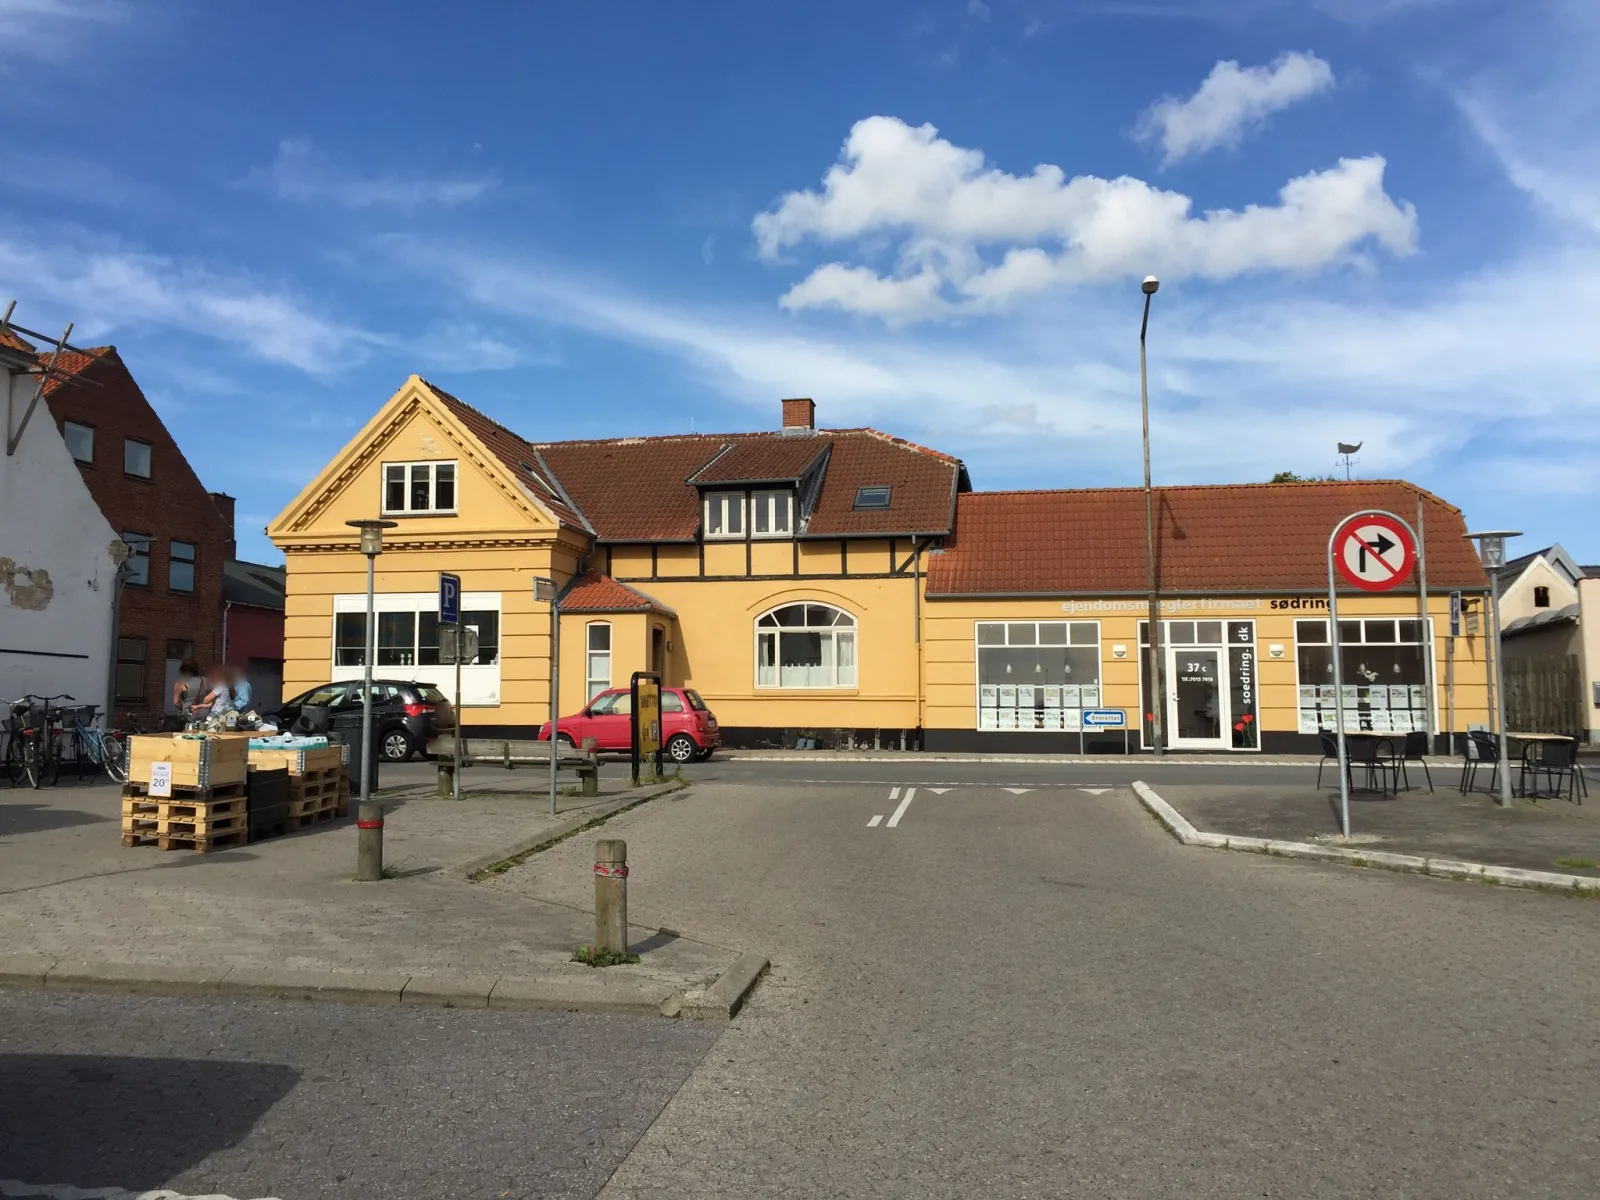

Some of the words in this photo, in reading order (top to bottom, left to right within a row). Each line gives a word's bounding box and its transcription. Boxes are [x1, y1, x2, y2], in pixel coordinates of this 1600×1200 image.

[443, 582, 455, 608] P
[1187, 662, 1200, 672] 37
[153, 778, 165, 788] 20
